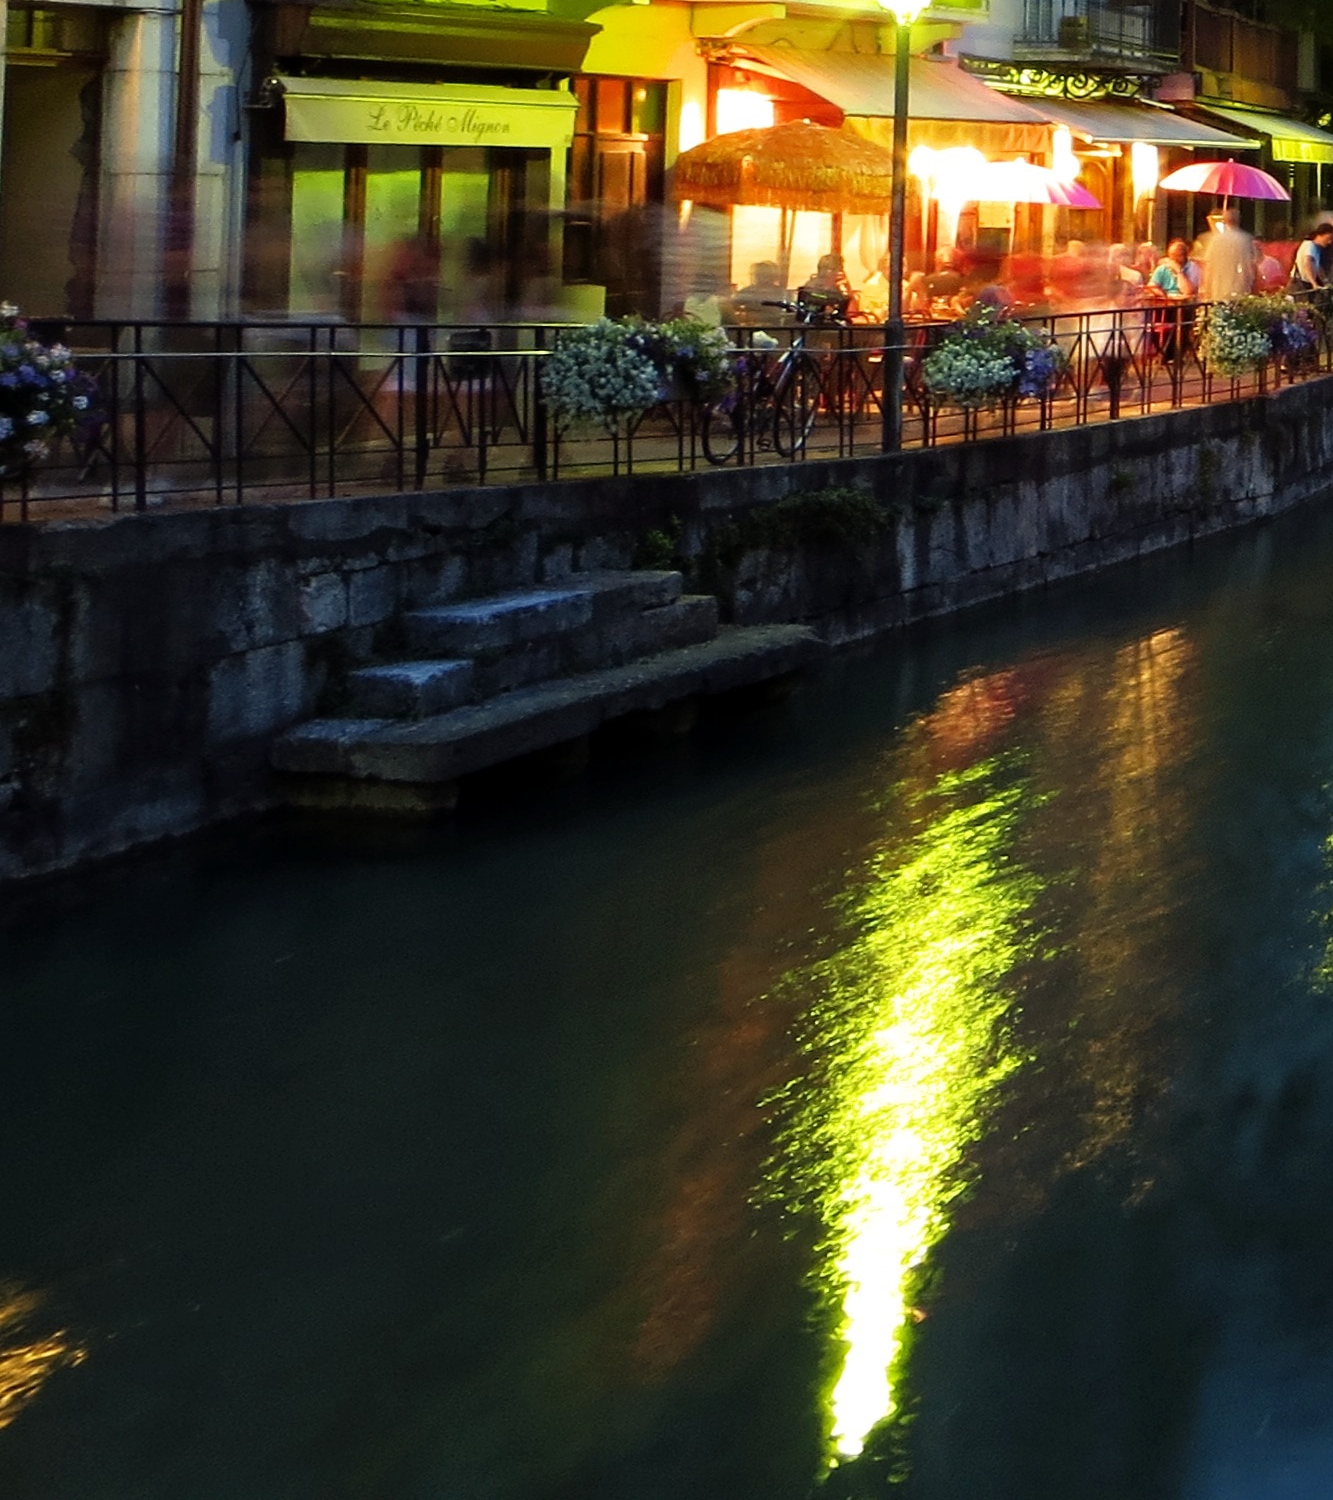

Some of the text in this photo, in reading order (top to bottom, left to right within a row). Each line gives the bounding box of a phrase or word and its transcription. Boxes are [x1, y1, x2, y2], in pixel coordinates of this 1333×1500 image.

[366, 101, 511, 143] Le Péché Mignon
